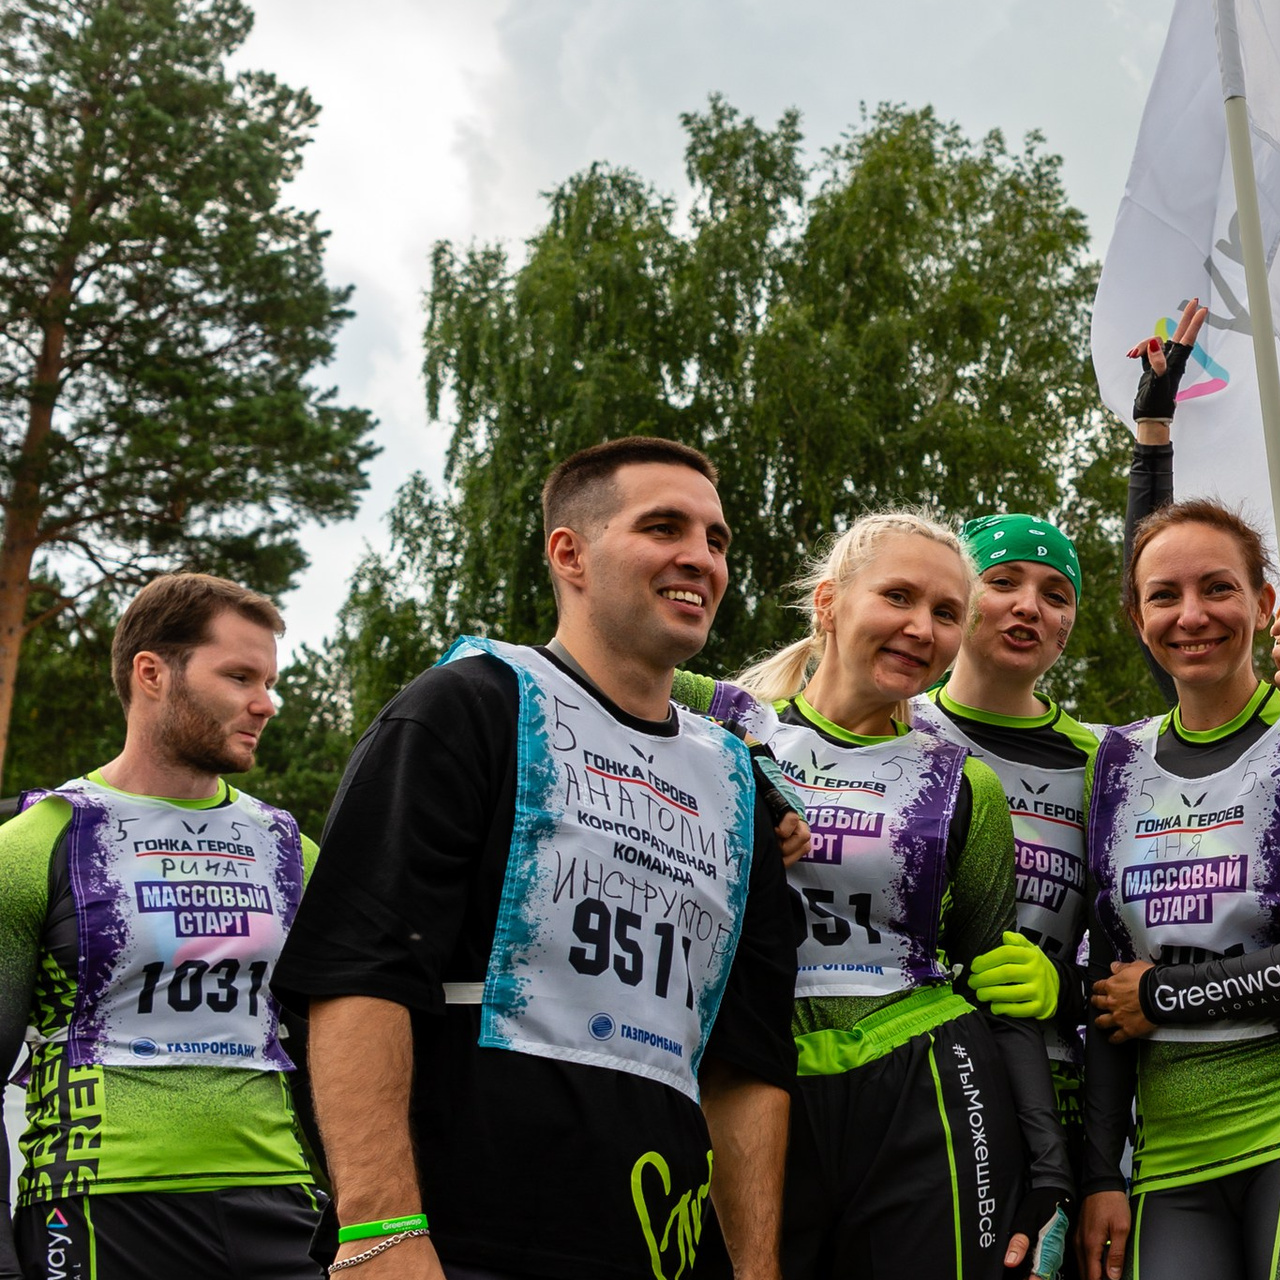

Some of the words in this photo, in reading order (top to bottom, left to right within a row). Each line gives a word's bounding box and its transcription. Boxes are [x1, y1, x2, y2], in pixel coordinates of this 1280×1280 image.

[553, 695, 581, 753] 5
[583, 749, 645, 781] ГОНКА
[646, 768, 700, 811] ГЕРОЕВ
[812, 775, 887, 795] ГЕРОЕВ
[1133, 775, 1162, 817] 5
[115, 817, 141, 842] 5
[230, 821, 249, 841] 5
[1135, 814, 1182, 834] ГОНКА
[1187, 804, 1246, 828] ГЕРОЕВ
[133, 838, 191, 854] ГОНКА
[197, 839, 256, 858] ГЕРОЕВ
[577, 809, 718, 881] КОРПОРАТИВНАЯ
[1143, 833, 1203, 861] АНЯ
[612, 841, 695, 888] КОМАНДА
[1125, 854, 1242, 897] МАССОВЫЙ
[142, 884, 269, 910] МАССОВЫЙ
[1149, 893, 1208, 924] СТАРТ
[178, 911, 244, 935] СТАРТ
[136, 958, 269, 1017] 1031
[1208, 995, 1280, 1017] GLOBAL
[166, 1041, 257, 1058] ГАЗПРОМБАНК
[620, 1023, 684, 1058] ГАЗПРОМБАНК
[952, 1042, 996, 1249] #ТыМожешьВсё
